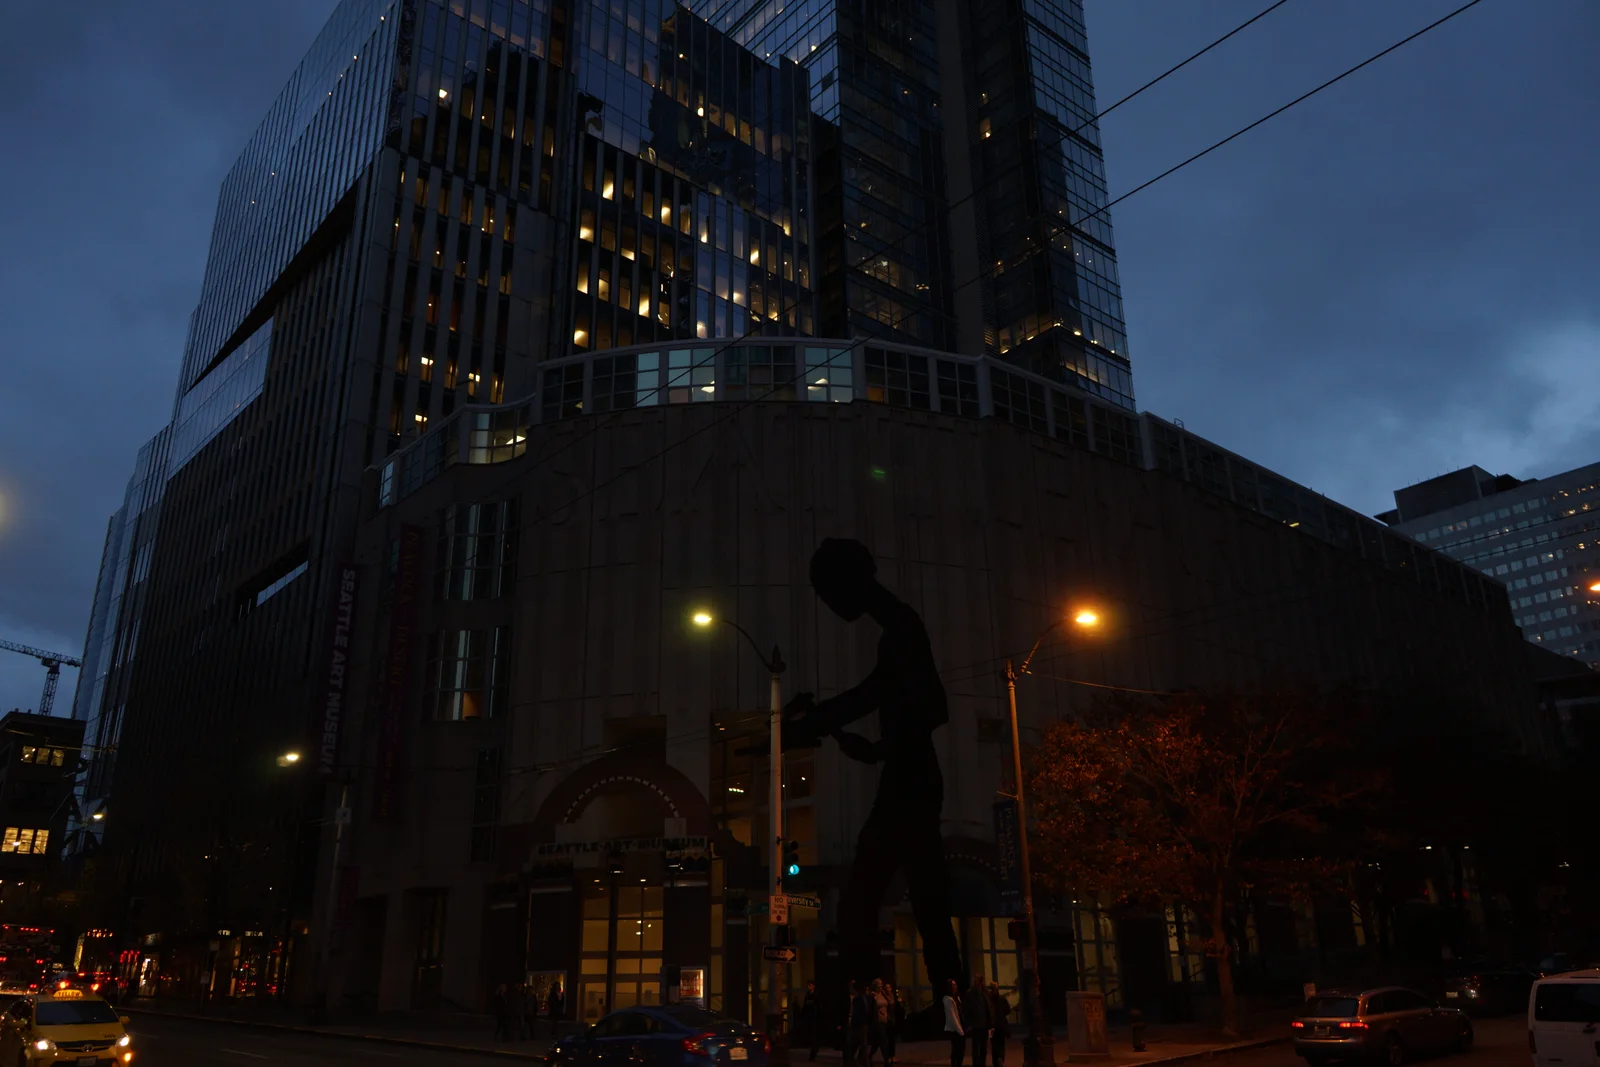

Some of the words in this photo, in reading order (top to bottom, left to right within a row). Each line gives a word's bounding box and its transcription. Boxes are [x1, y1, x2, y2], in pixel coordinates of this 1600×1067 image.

[334, 568, 356, 648] SEATTLE
[329, 649, 347, 690] ART
[318, 692, 342, 775] MUSEUM
[538, 841, 599, 855] SEATTLE
[774, 896, 784, 904] NO
